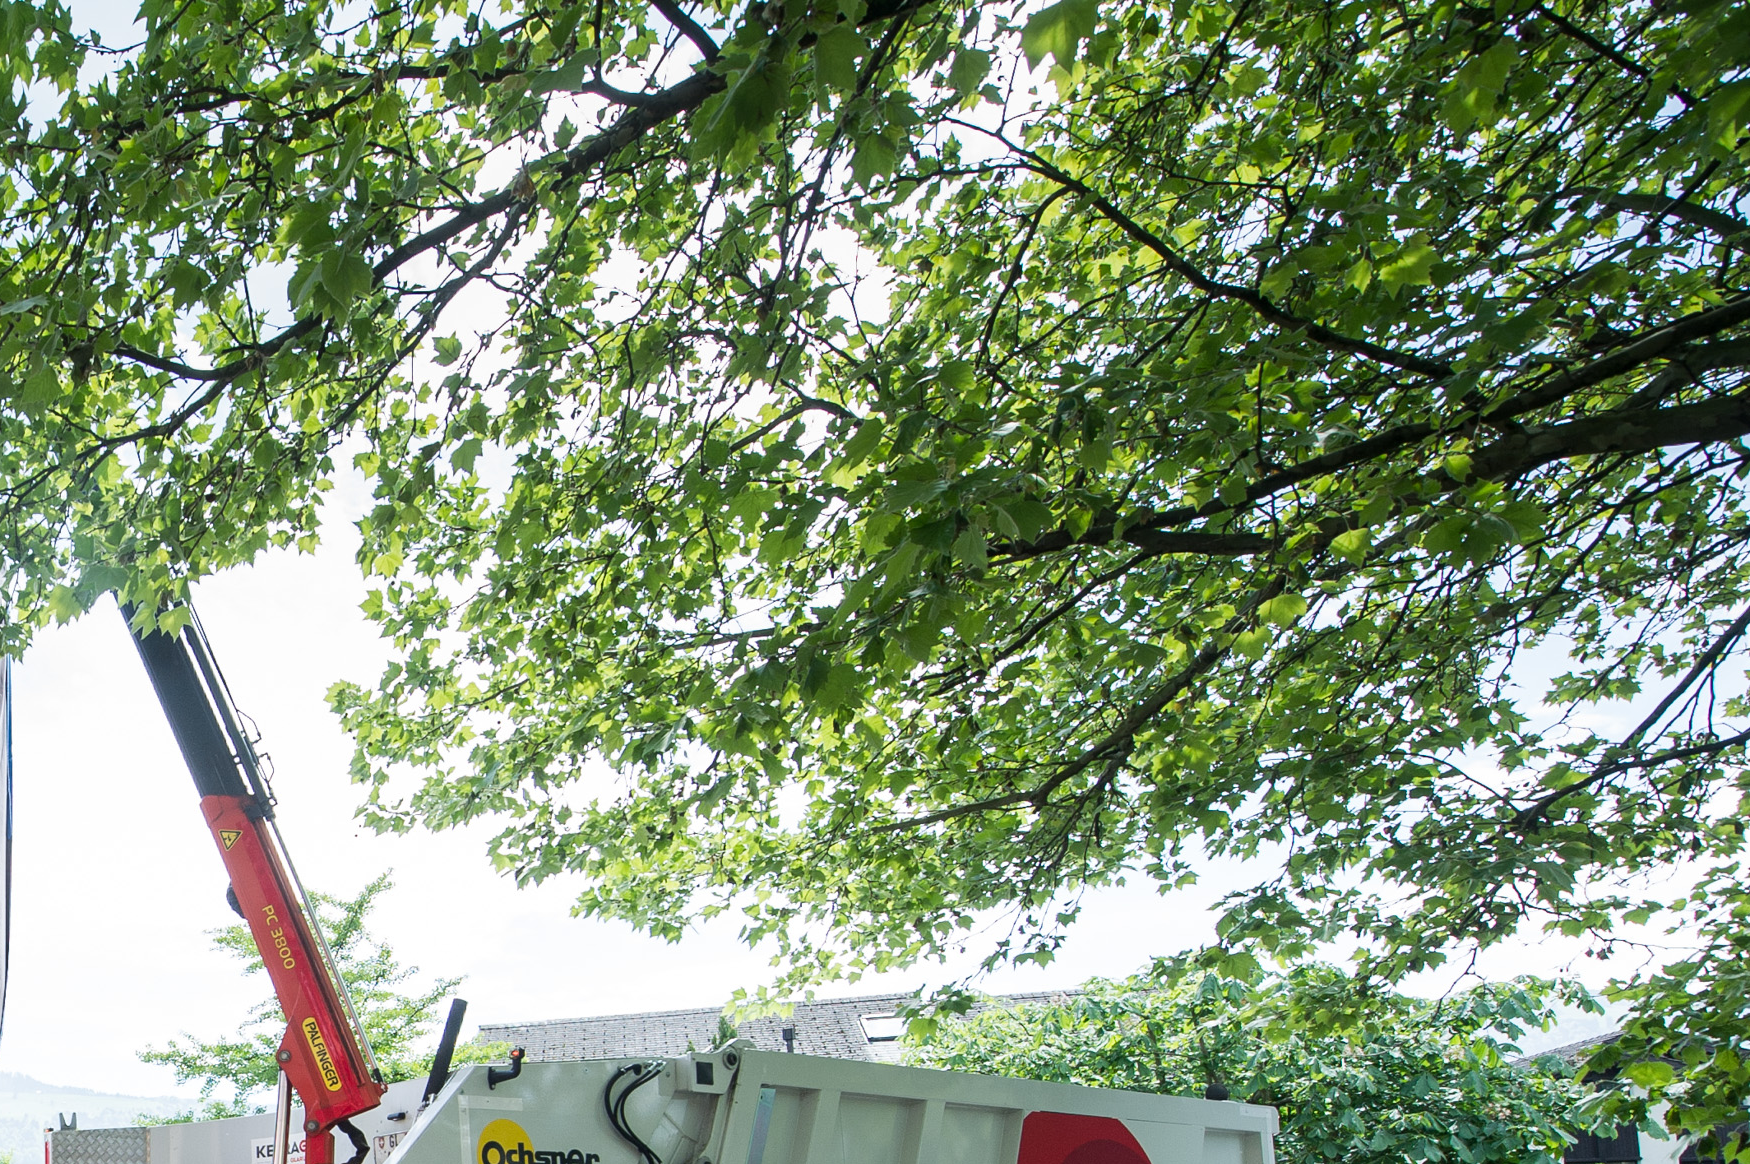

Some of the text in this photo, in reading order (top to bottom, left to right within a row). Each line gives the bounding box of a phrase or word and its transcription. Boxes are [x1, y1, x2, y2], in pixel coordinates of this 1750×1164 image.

[262, 904, 295, 970] PC 3800
[304, 1021, 339, 1088] PALFINGER
[256, 1140, 306, 1158] KEAG
